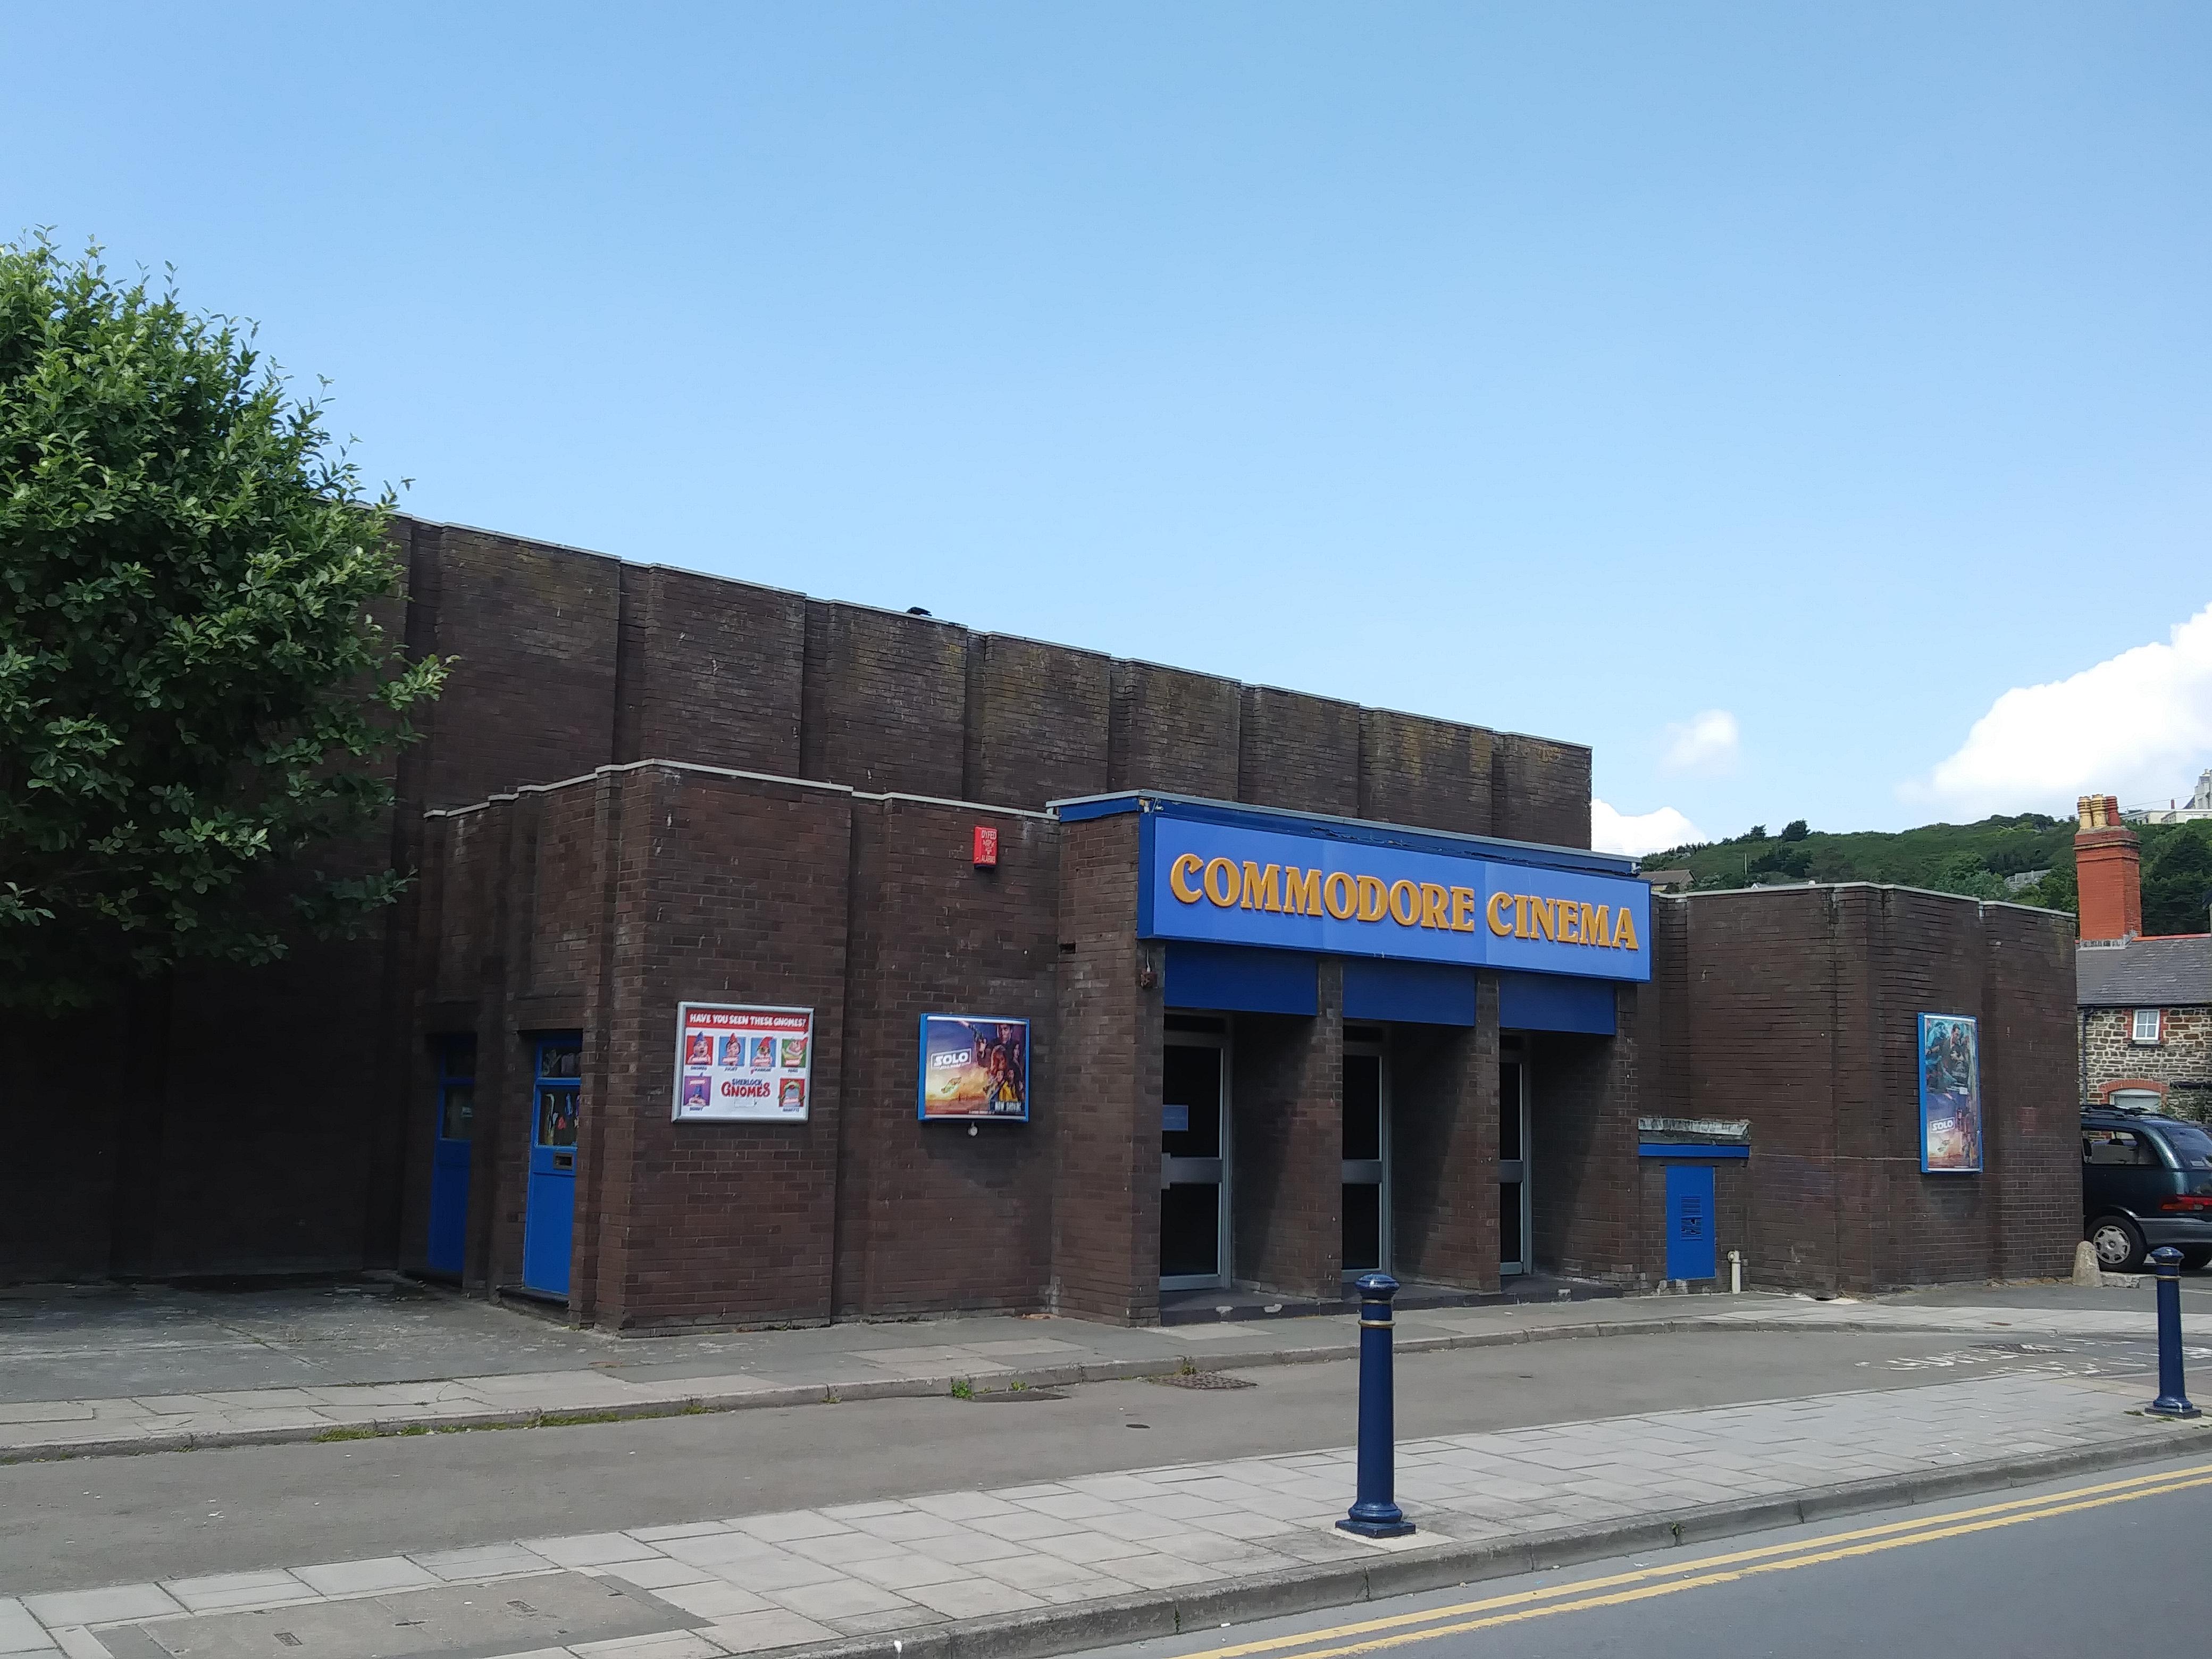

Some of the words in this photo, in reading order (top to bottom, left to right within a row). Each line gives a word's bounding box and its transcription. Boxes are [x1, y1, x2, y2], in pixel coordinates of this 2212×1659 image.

[981, 830, 996, 840] DYFED
[1171, 853, 1474, 932] COMMODORE
[1487, 892, 1639, 951] CINEMA
[690, 1013, 711, 1023] HAVE
[713, 1014, 728, 1024] YOU
[729, 1015, 749, 1025] SEEN
[750, 1016, 773, 1026] THESE
[774, 1017, 807, 1027] GNOMES?
[934, 1052, 968, 1067] SOLO
[721, 1080, 770, 1097] GNOMES
[1932, 1120, 1954, 1131] SOLO
